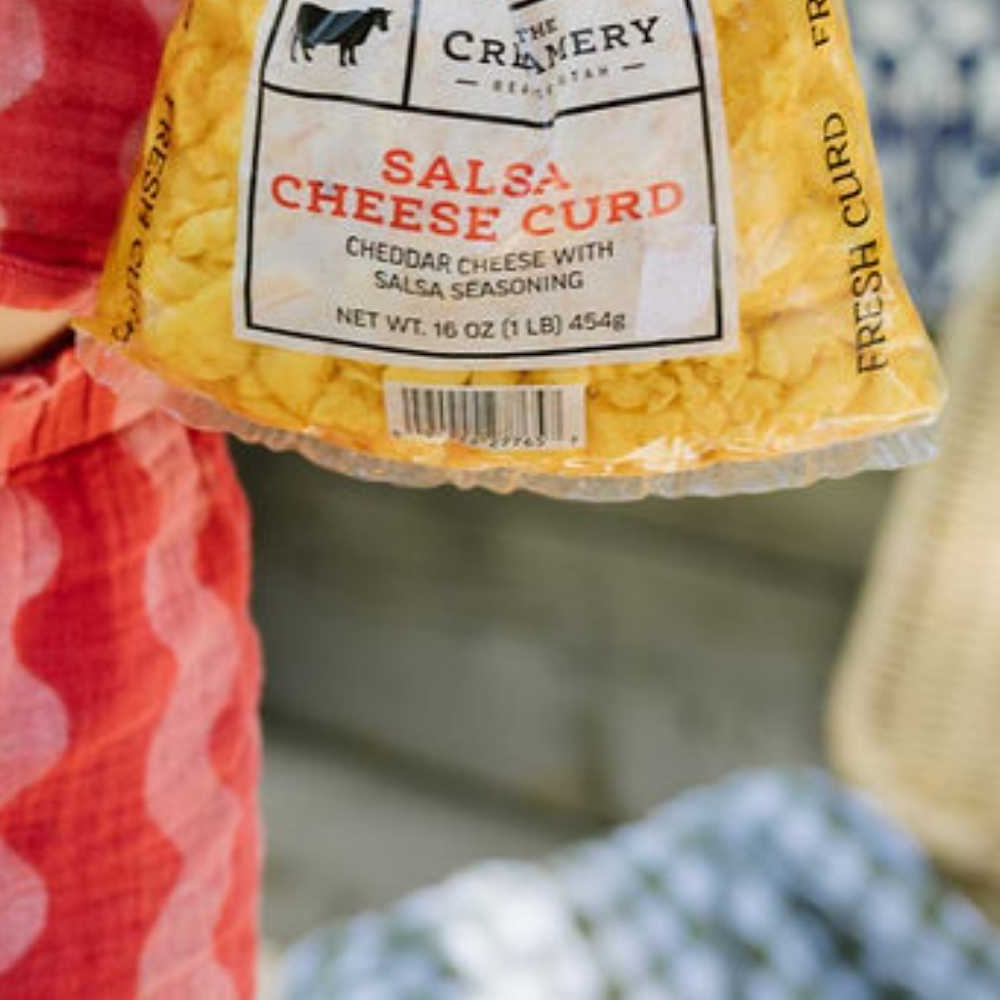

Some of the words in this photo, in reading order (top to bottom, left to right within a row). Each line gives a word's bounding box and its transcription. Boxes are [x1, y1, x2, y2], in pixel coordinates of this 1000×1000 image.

[515, 18, 557, 43] THE
[381, 147, 571, 198] SALSA
[823, 111, 871, 228] CURD
[271, 173, 500, 242] CHEESE
[521, 180, 684, 236] CURD
[345, 235, 452, 274] CHEDDAR
[457, 249, 546, 275] CHEESE
[552, 240, 614, 265] WITH
[374, 269, 444, 300] SALSA
[450, 270, 584, 300] SEASONING
[850, 238, 888, 375] FRESH
[336, 305, 379, 329] NET
[385, 314, 427, 336] WT.
[433, 319, 458, 339] 16
[463, 319, 495, 340] OZ
[501, 317, 519, 341] (1
[526, 313, 562, 336] LB)
[567, 311, 625, 332] 454g
